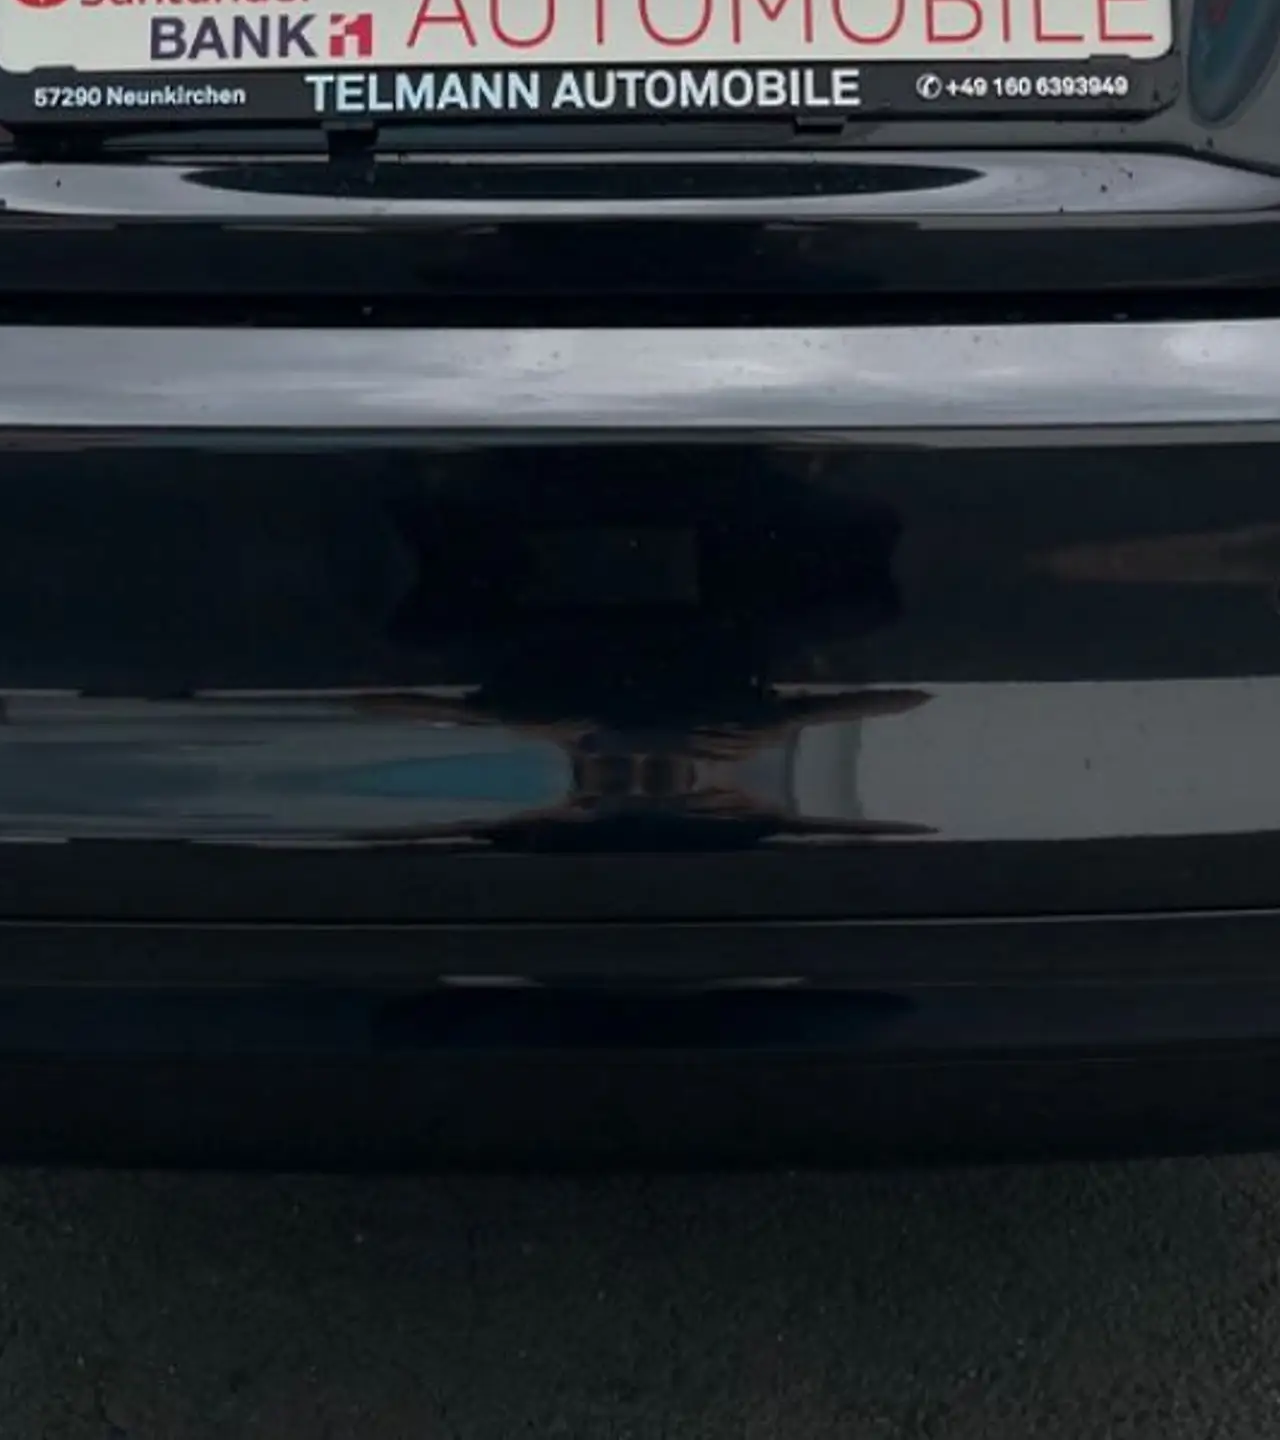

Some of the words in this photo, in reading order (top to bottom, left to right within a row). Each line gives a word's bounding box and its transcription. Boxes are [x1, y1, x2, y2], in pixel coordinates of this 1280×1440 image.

[34, 86, 102, 108] 57290
[106, 85, 246, 106] Neunkirchen
[304, 72, 539, 113] TELMANN
[552, 69, 862, 109] AUTOMOBILE
[946, 76, 988, 97] +49
[993, 76, 1032, 97] 160
[1036, 76, 1129, 96] 6393949
